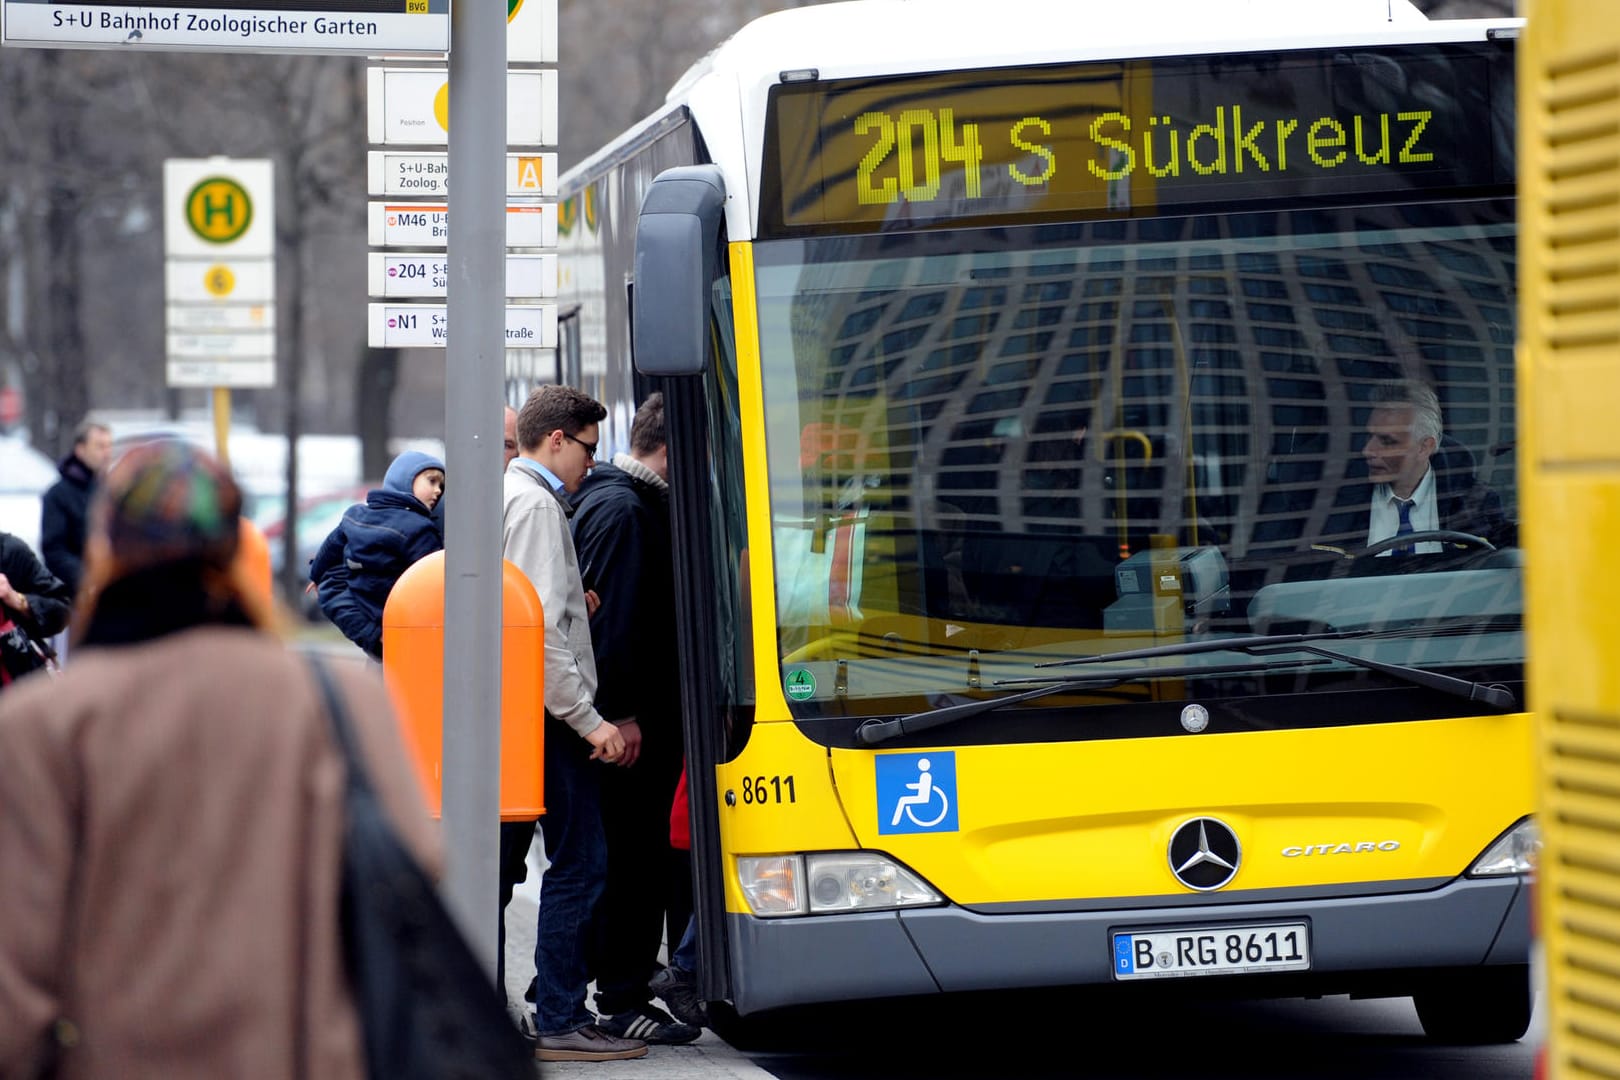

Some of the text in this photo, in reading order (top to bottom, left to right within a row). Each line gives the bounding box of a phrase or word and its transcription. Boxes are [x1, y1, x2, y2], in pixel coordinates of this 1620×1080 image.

[408, 1, 426, 12] BVG
[53, 11, 378, 37] S+U Bahnhof Zoologischer Garten
[854, 108, 983, 204] 204
[1009, 116, 1056, 185] S
[1088, 105, 1433, 180] Südkreuz
[399, 162, 447, 175] S+U-Bah
[519, 162, 542, 189] A
[399, 177, 441, 191] Zoolog.
[204, 194, 234, 226] H
[398, 214, 427, 226] M46
[432, 213, 448, 224] U-
[432, 226, 447, 237] Bri
[398, 264, 426, 278] 204
[432, 277, 446, 288] Sü
[398, 315, 417, 329] N1
[432, 315, 447, 325] S+
[431, 328, 534, 339] Wa traße
[795, 670, 804, 686] 4
[742, 775, 796, 804] 8611
[1281, 840, 1400, 858] CITARO
[1134, 931, 1303, 970] B RG 8611
[1120, 959, 1129, 968] D
